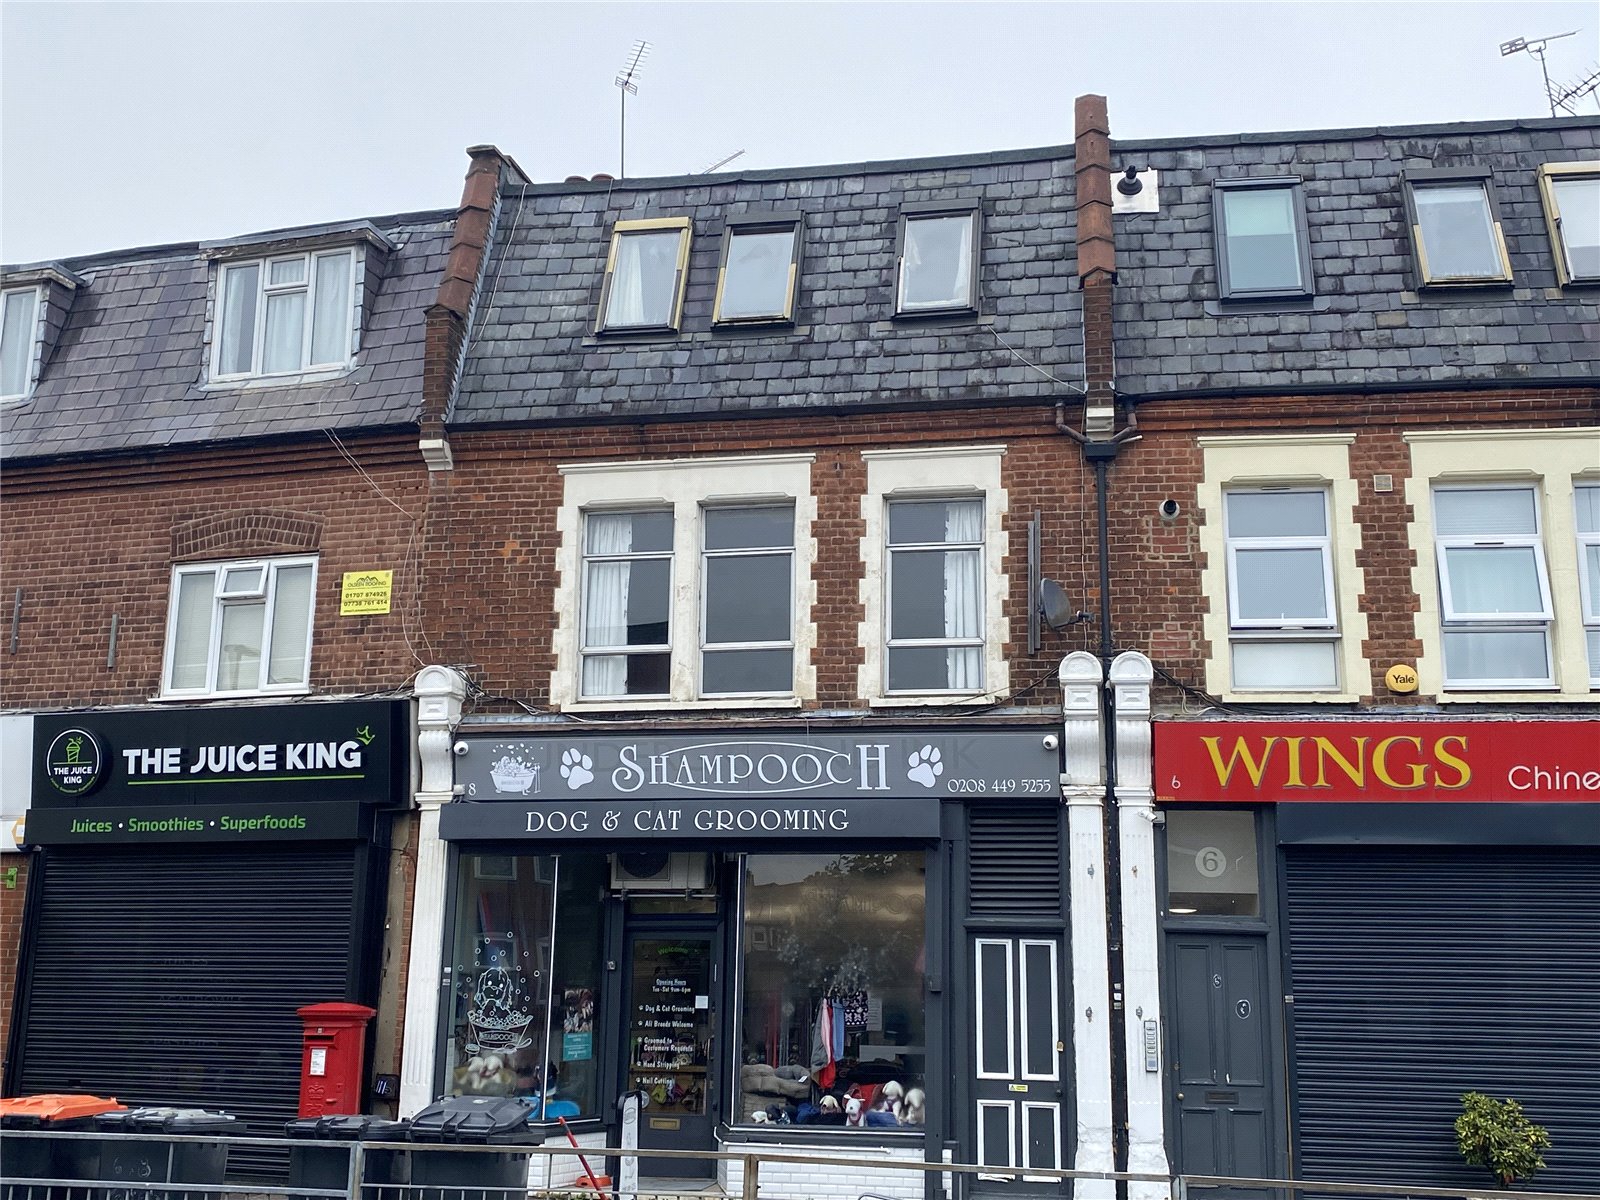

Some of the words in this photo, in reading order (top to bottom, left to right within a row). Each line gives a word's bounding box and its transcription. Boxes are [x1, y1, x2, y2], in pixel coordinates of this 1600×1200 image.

[1393, 674, 1414, 683] Yale
[122, 747, 181, 775] THE
[190, 744, 277, 773] JUICE
[285, 741, 362, 770] KING
[1200, 735, 1473, 791] WINGS
[54, 767, 69, 775] THE
[70, 766, 92, 775] JUICE
[611, 744, 891, 792] SHAMPOOCH
[64, 776, 82, 784] KING
[1171, 775, 1181, 789] 6
[1508, 765, 1600, 790] Chine
[468, 783, 477, 796] 8
[947, 778, 986, 793] 0208
[992, 778, 1016, 793] 449
[1021, 779, 1052, 793] 5255
[71, 819, 113, 834] Juices
[128, 817, 204, 833] Smoothies
[220, 815, 306, 833] Superfoods
[525, 811, 589, 832] DOG
[602, 811, 621, 831] &
[633, 809, 682, 831] CAT
[694, 808, 849, 831] GROOMING
[1202, 851, 1219, 871] 6
[645, 1004, 655, 1013] Dog
[661, 1004, 670, 1012] Cat
[671, 1004, 695, 1014] Grooming
[644, 1020, 653, 1028] All
[653, 1020, 671, 1028] Breeds
[671, 1020, 694, 1028] Welcome
[656, 1060, 680, 1070] Stripping
